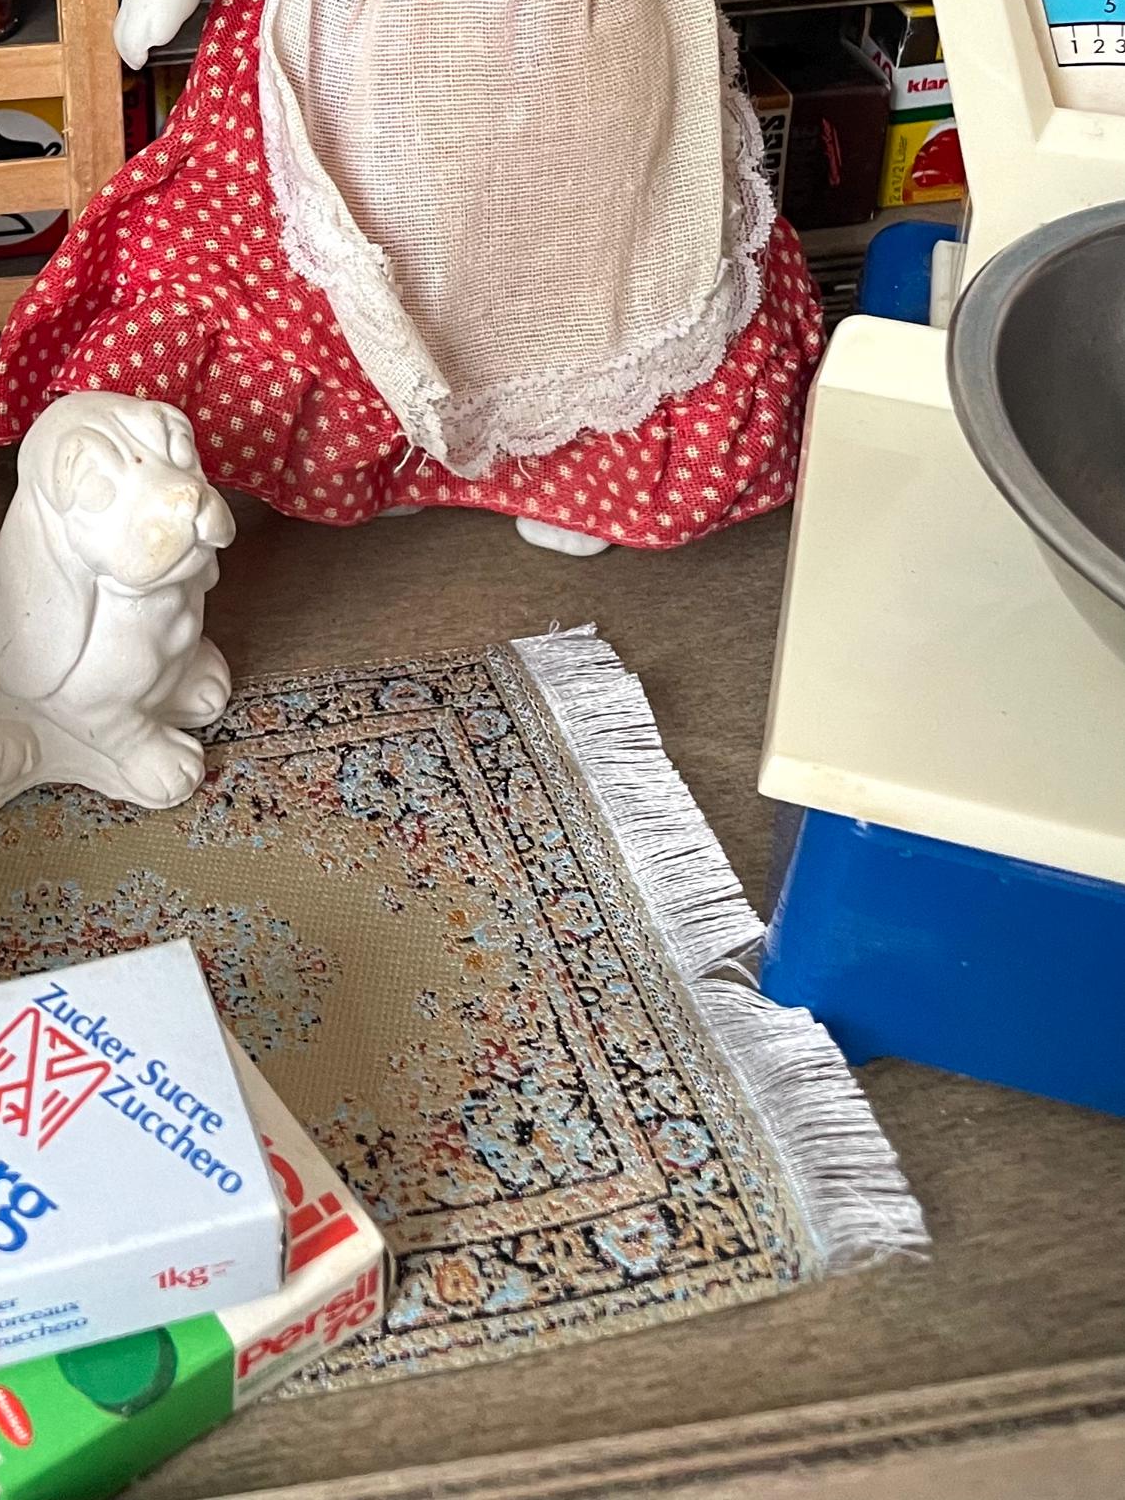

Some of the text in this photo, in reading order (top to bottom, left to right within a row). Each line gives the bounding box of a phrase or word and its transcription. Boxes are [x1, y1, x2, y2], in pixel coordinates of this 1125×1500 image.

[1071, 40, 1078, 54] 1
[1093, 39, 1105, 54] 2
[907, 78, 948, 93] klar
[32, 982, 224, 1134] Zucker Sucre
[98, 1077, 243, 1194] Zucchero
[151, 1265, 210, 1290] 1kg
